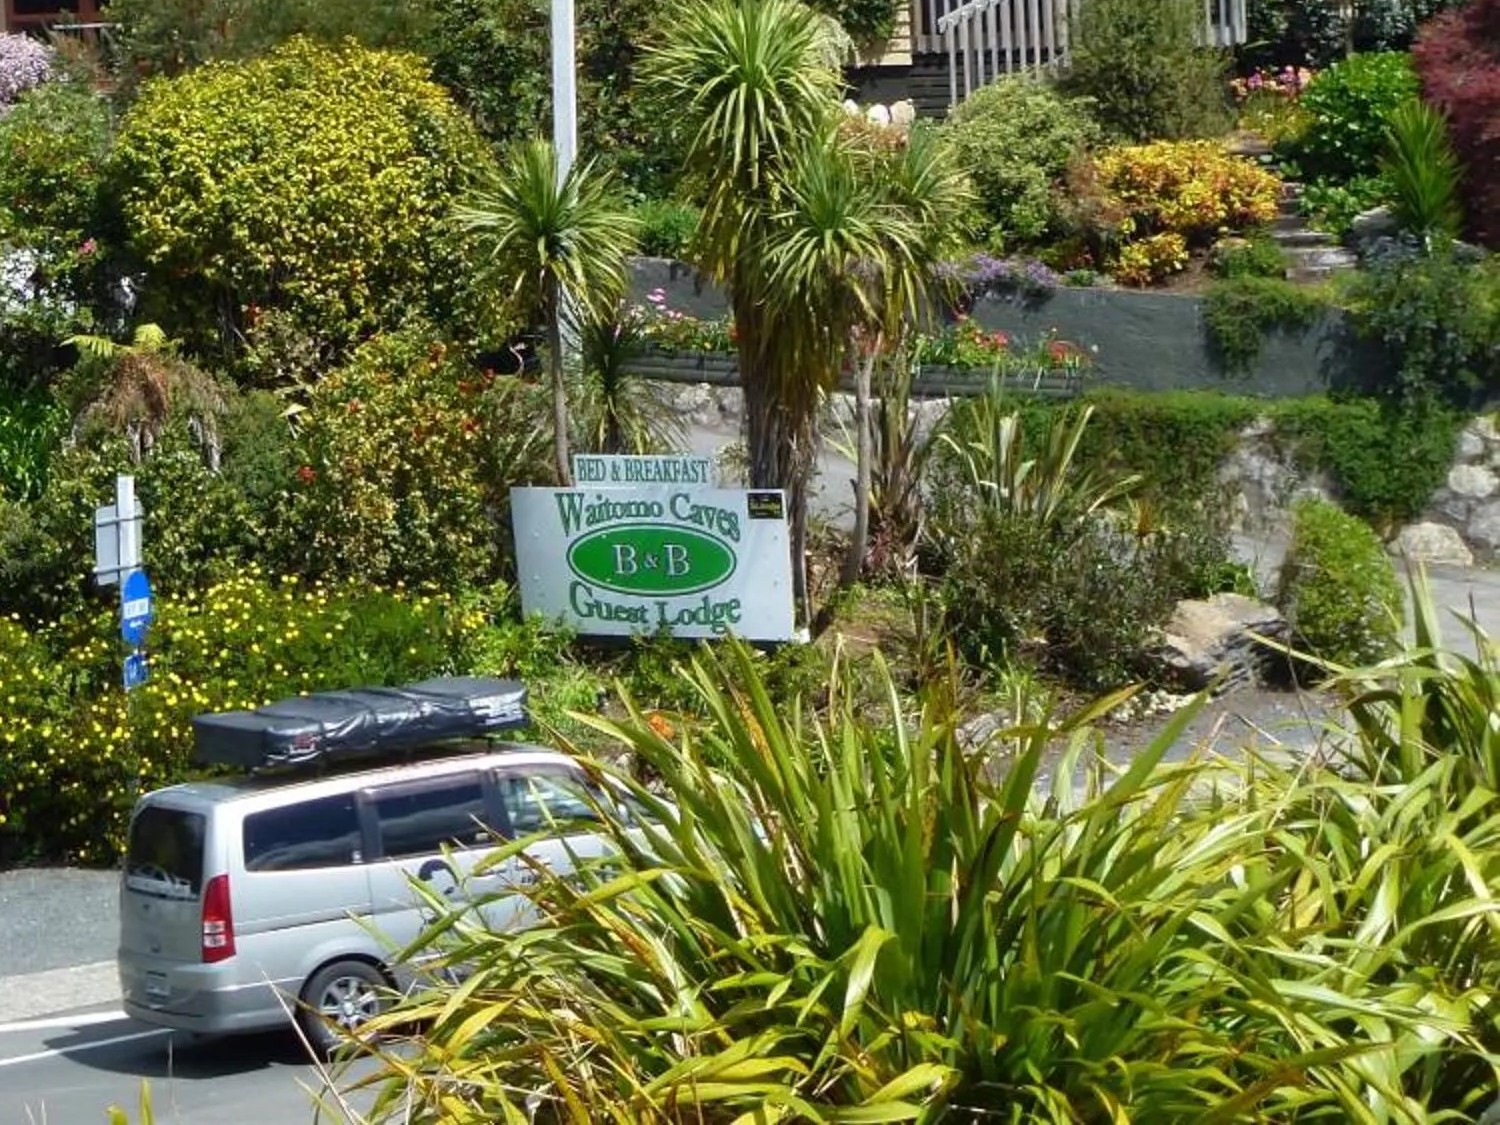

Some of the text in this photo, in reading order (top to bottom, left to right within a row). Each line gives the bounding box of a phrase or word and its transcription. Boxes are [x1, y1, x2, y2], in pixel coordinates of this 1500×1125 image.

[576, 458, 709, 483] BED & BREAKFAST
[554, 492, 664, 538] Waitomo
[669, 492, 741, 542] Caves
[612, 543, 690, 577] B & B
[569, 579, 742, 635] Guest Lodge
